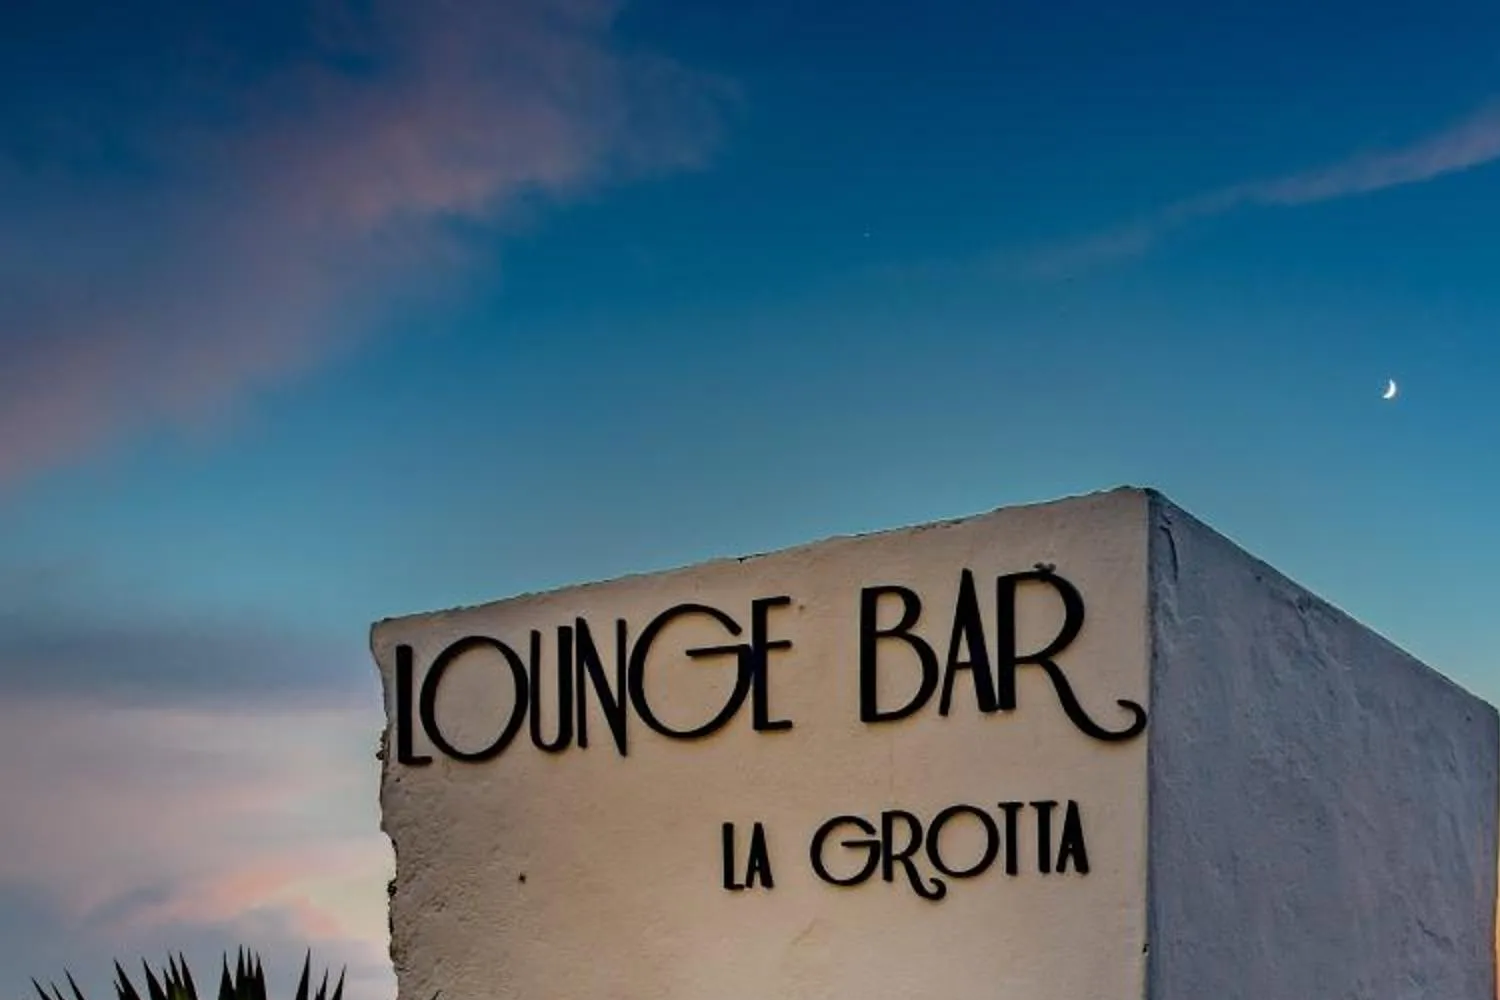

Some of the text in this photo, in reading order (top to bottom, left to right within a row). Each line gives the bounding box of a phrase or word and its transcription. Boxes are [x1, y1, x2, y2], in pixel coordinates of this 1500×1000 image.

[395, 565, 1148, 767] LOUNGE BAR
[722, 799, 1090, 902] LA GROTTA
